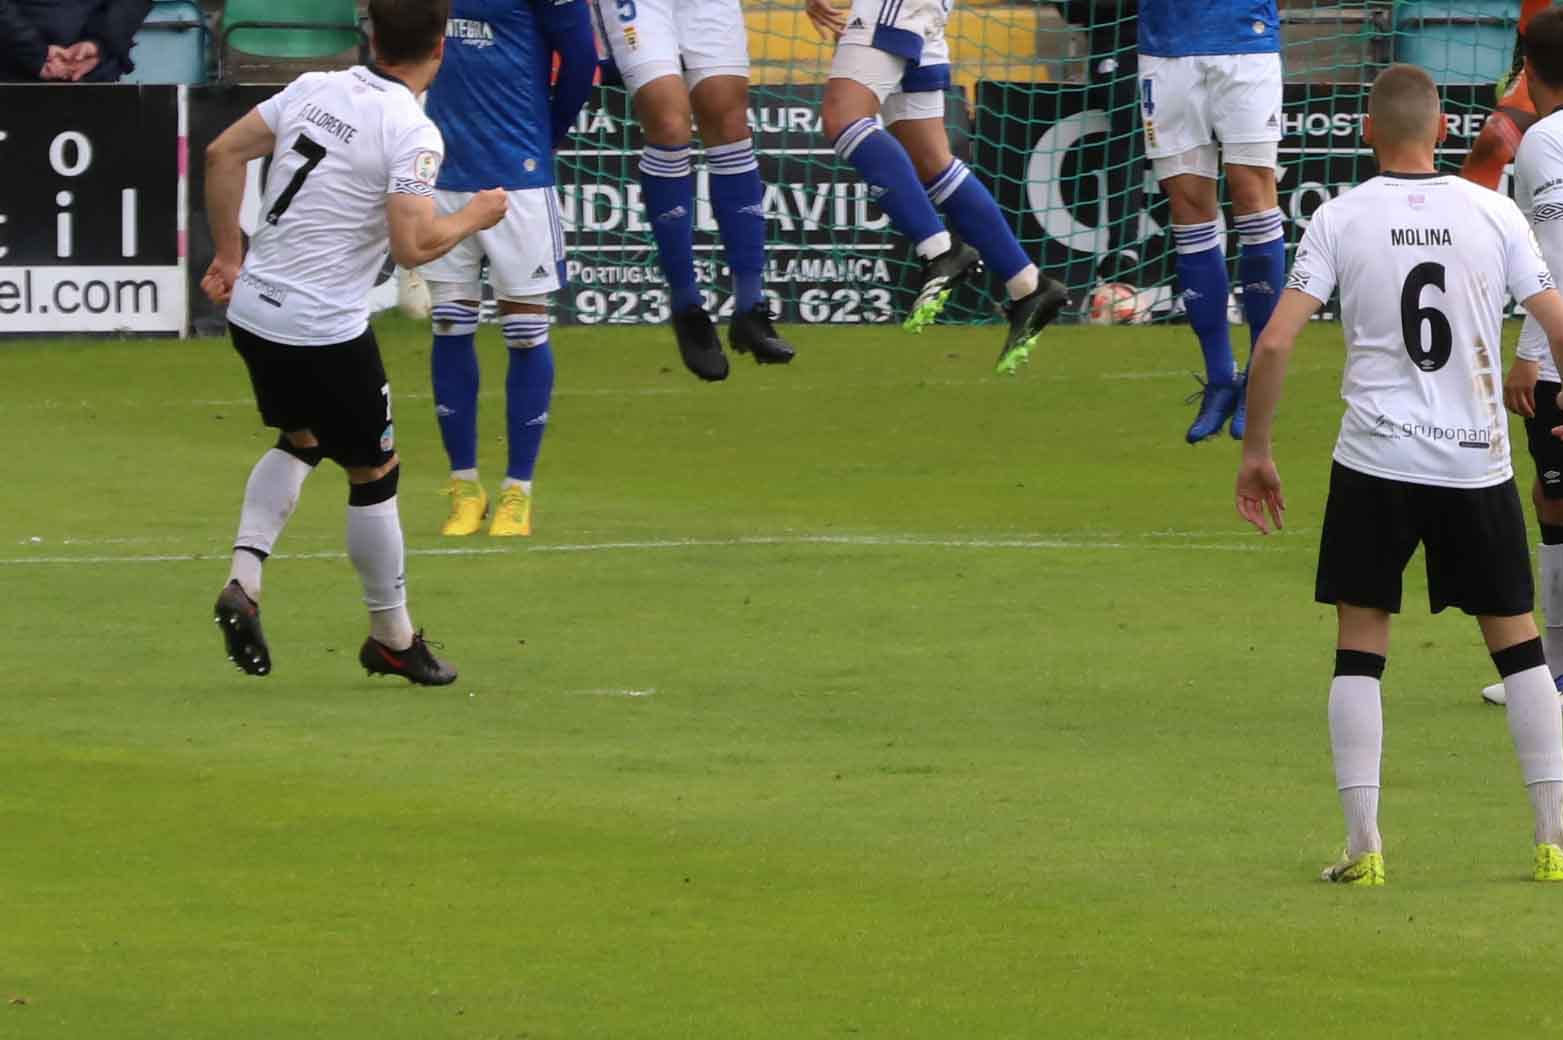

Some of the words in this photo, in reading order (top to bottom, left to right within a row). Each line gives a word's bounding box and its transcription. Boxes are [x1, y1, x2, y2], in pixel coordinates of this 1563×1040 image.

[266, 132, 327, 226] 7
[1391, 228, 1452, 247] MOLINA
[575, 289, 672, 324] 923
[799, 288, 893, 323] 623
[1400, 261, 1453, 372] 6
